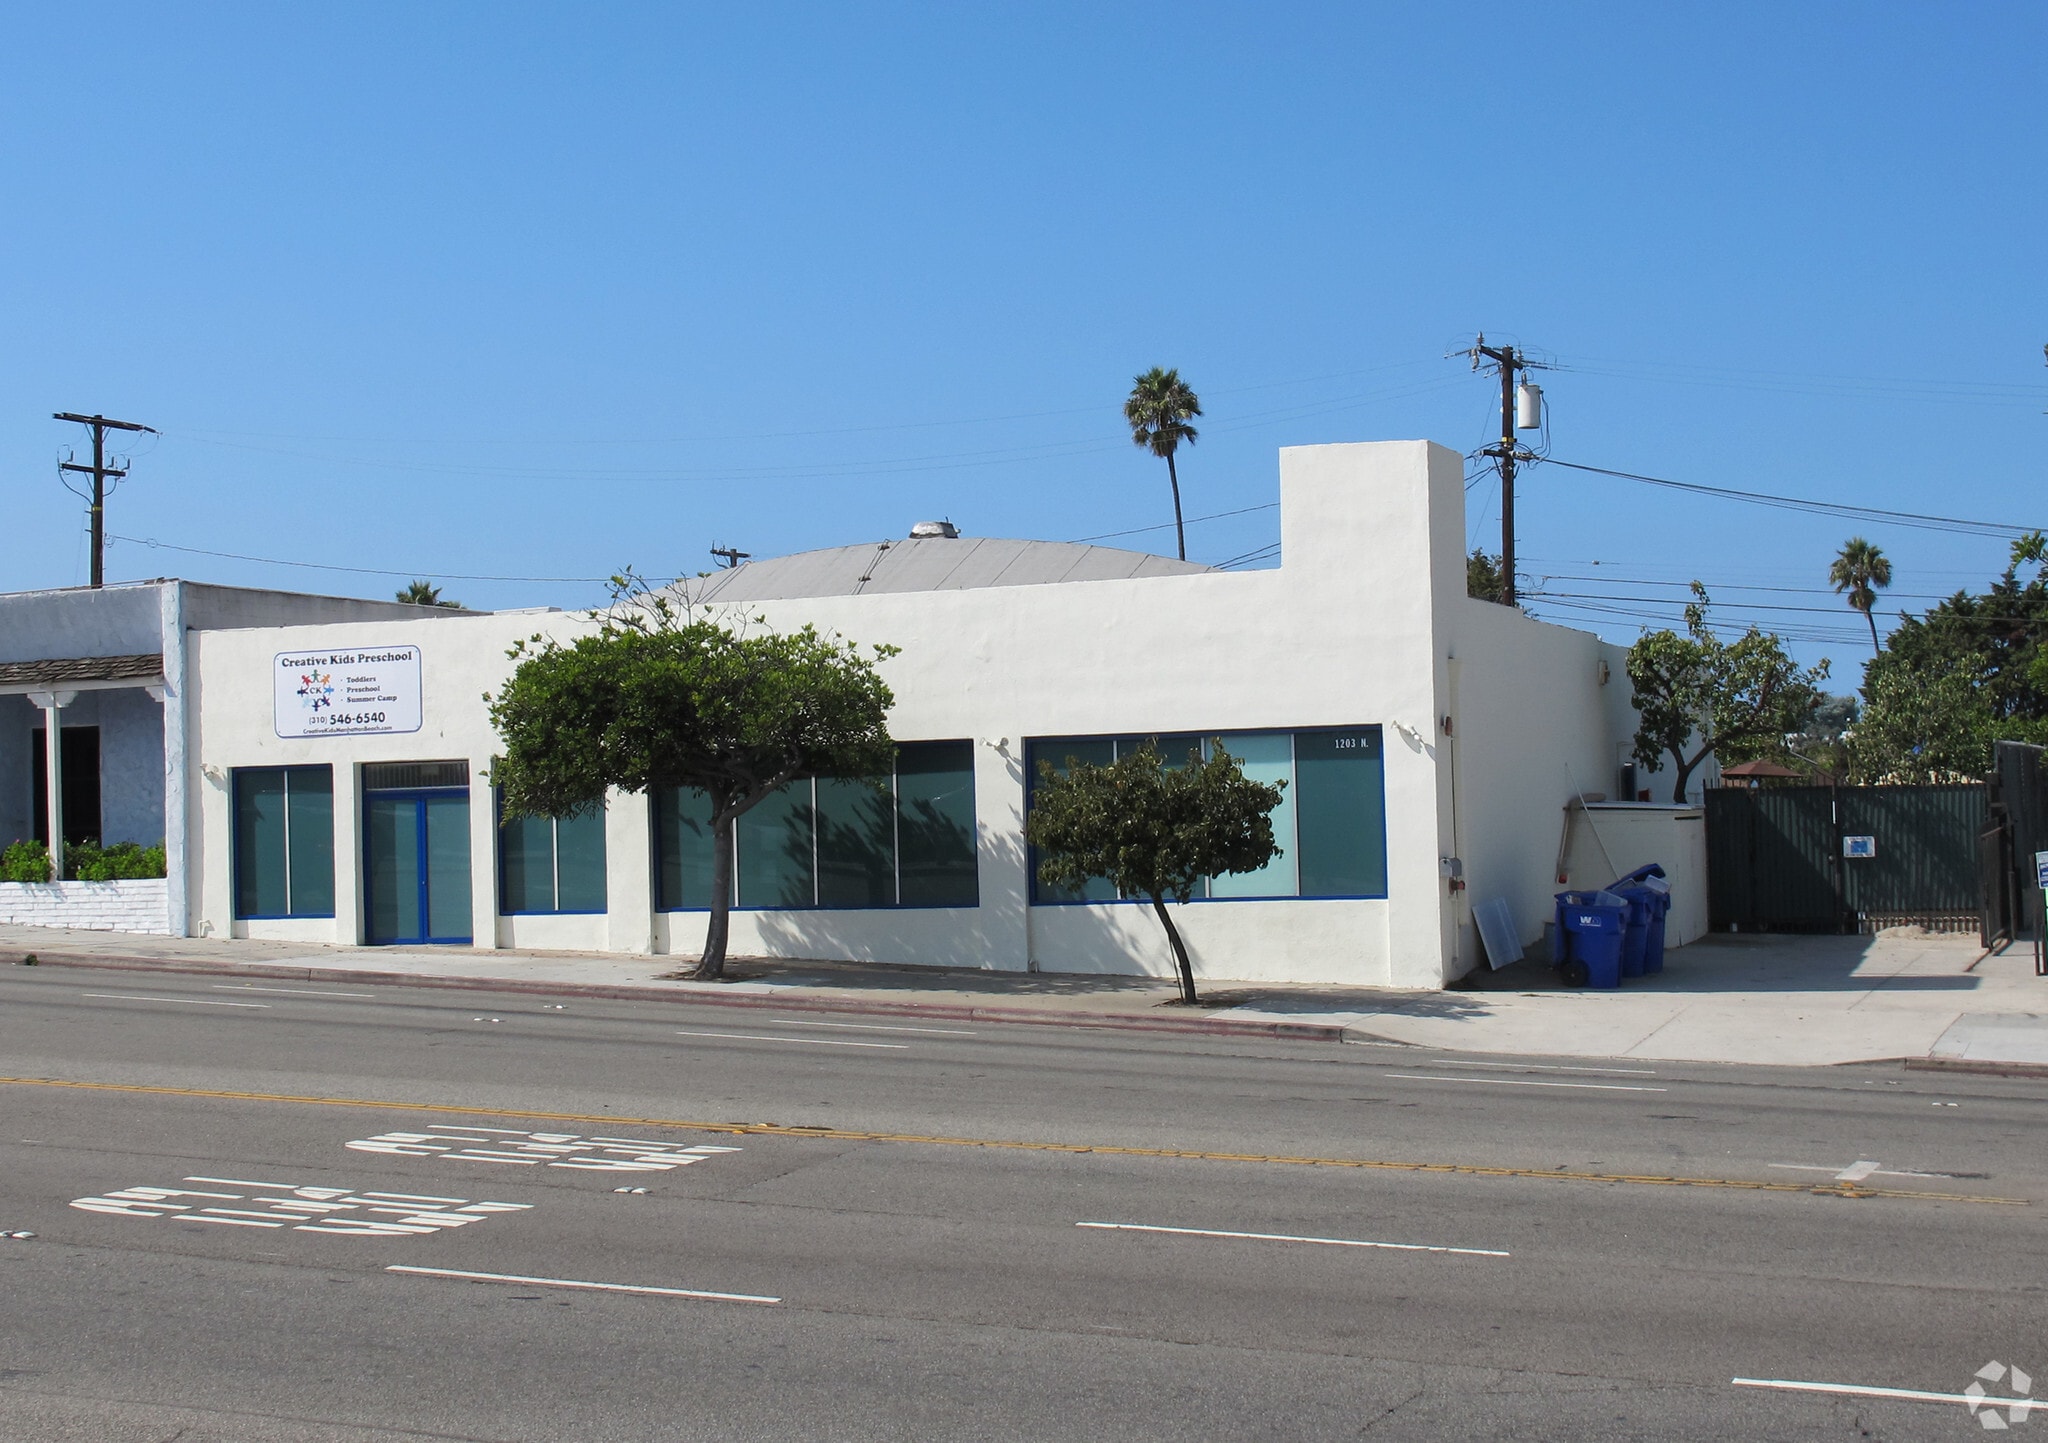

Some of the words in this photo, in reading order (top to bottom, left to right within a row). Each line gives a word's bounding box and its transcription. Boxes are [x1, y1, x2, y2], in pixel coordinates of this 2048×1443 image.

[281, 656, 328, 667] Creative
[330, 654, 355, 665] Kids
[358, 651, 412, 664] Preschool
[309, 686, 322, 695] CK
[346, 685, 380, 693] Preschool
[377, 695, 397, 703] Camp
[308, 716, 327, 725] (310)
[329, 711, 386, 725] 546-6540
[1335, 738, 1355, 748] 1203
